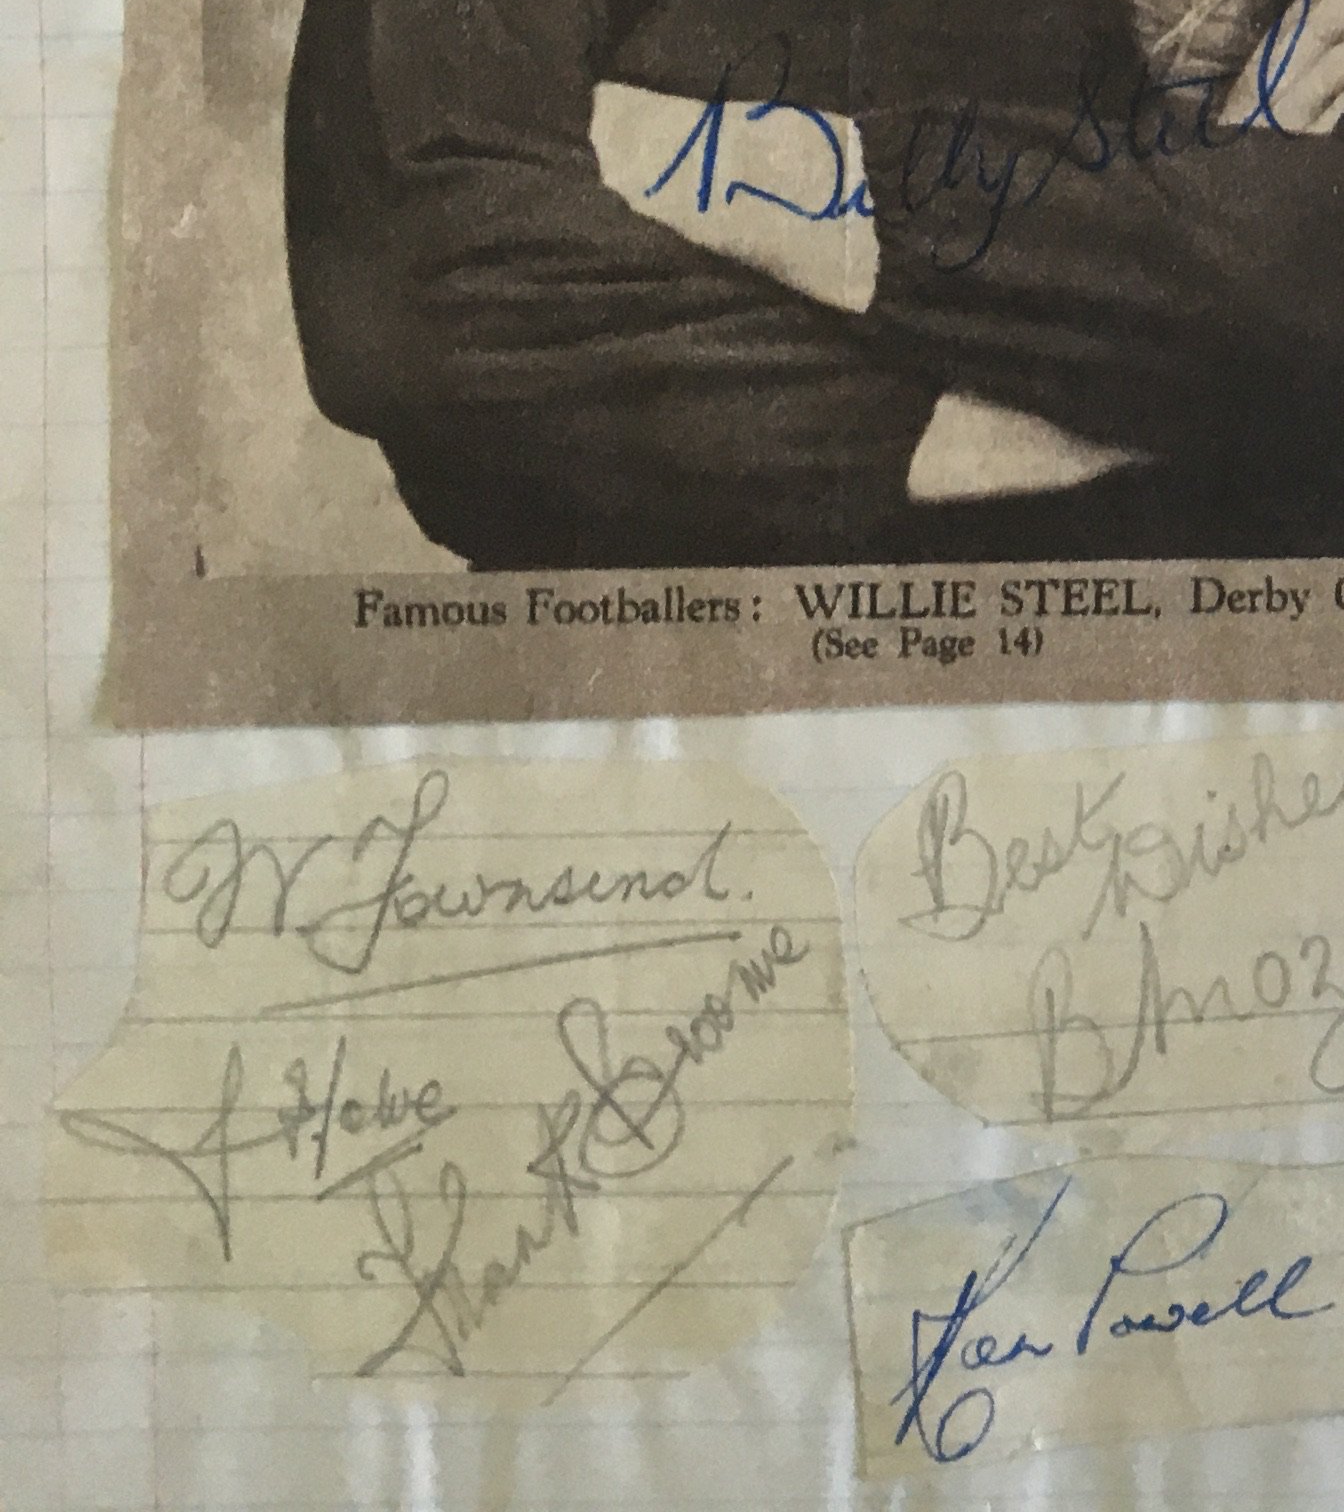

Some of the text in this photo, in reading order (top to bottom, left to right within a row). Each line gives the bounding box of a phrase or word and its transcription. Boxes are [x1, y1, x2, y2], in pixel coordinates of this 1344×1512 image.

[353, 588, 508, 628] Famous
[795, 578, 978, 620] WILLIE
[999, 578, 1163, 619] STEEL,
[1190, 575, 1312, 621] Derby
[811, 626, 1044, 665] (See Page 14)
